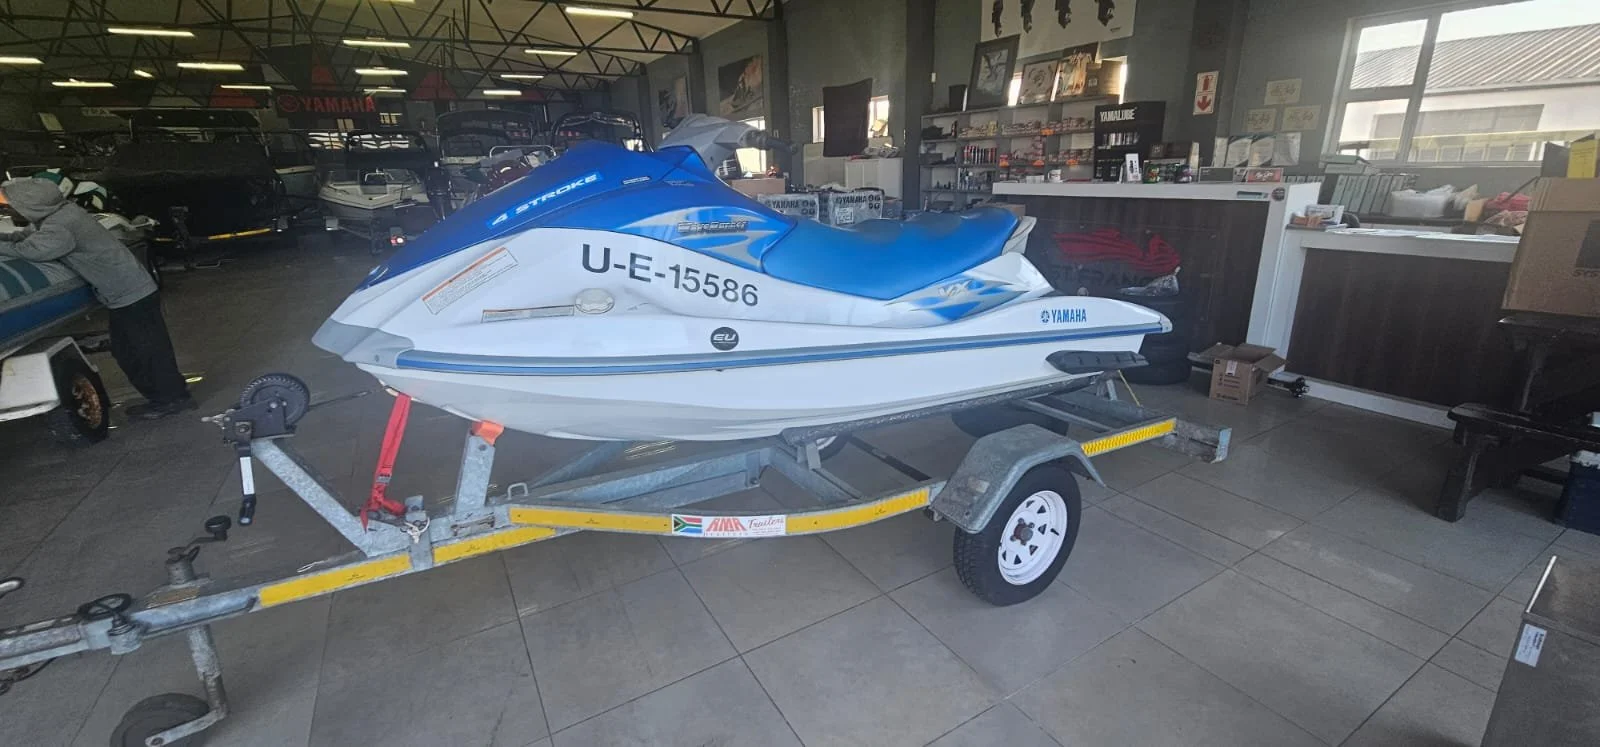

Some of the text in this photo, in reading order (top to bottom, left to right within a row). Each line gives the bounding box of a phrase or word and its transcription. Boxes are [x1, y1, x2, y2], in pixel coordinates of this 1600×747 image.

[303, 96, 376, 113] YAMAHA
[1099, 109, 1136, 122] YAMALUBE
[492, 174, 597, 226] 4 STROKE
[582, 243, 759, 307] U-E-15586
[1052, 308, 1087, 323] YAMAHA
[713, 333, 737, 341] EU
